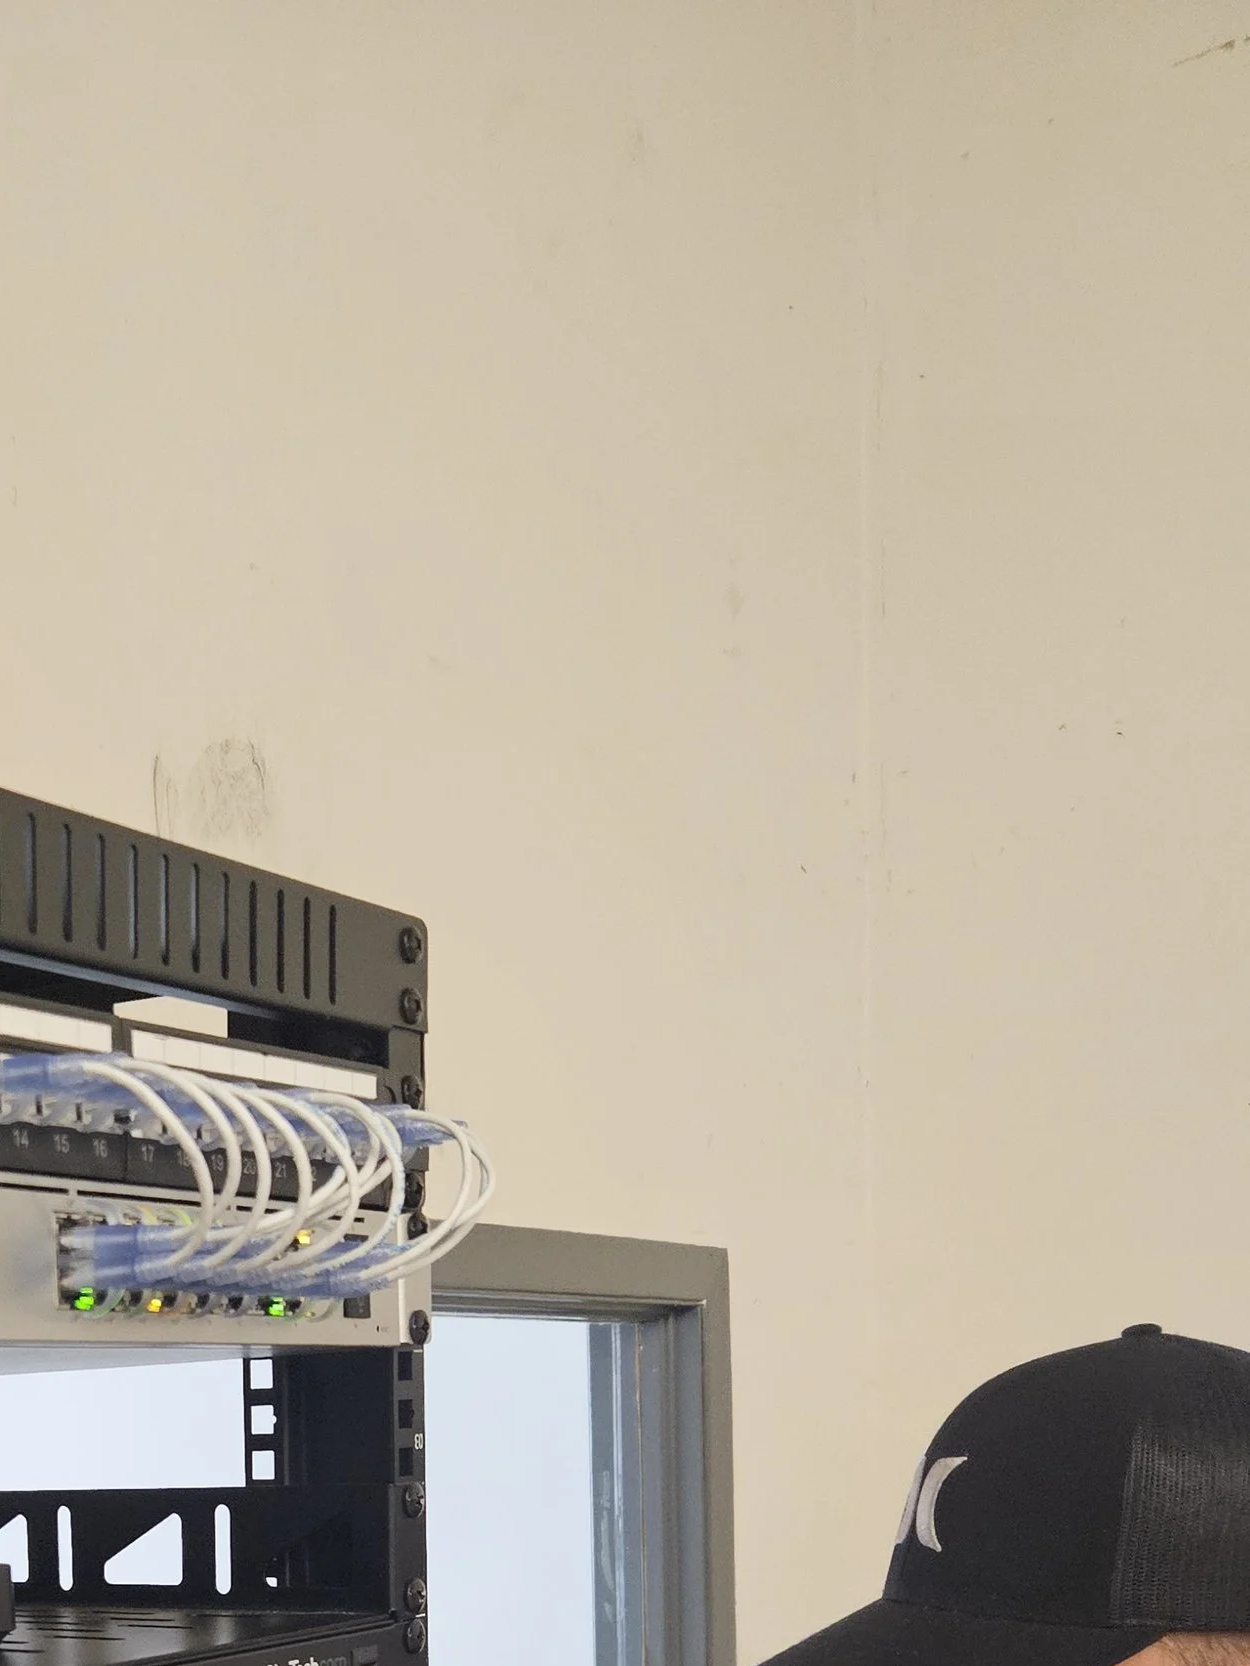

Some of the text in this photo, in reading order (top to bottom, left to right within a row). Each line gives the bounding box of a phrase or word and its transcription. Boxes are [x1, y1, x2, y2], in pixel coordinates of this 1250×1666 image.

[13, 1128, 30, 1150] 14
[53, 1133, 70, 1154] 15
[92, 1138, 108, 1158] 16
[141, 1145, 155, 1163] 17
[211, 1154, 225, 1171] 19
[275, 1161, 288, 1178] 21
